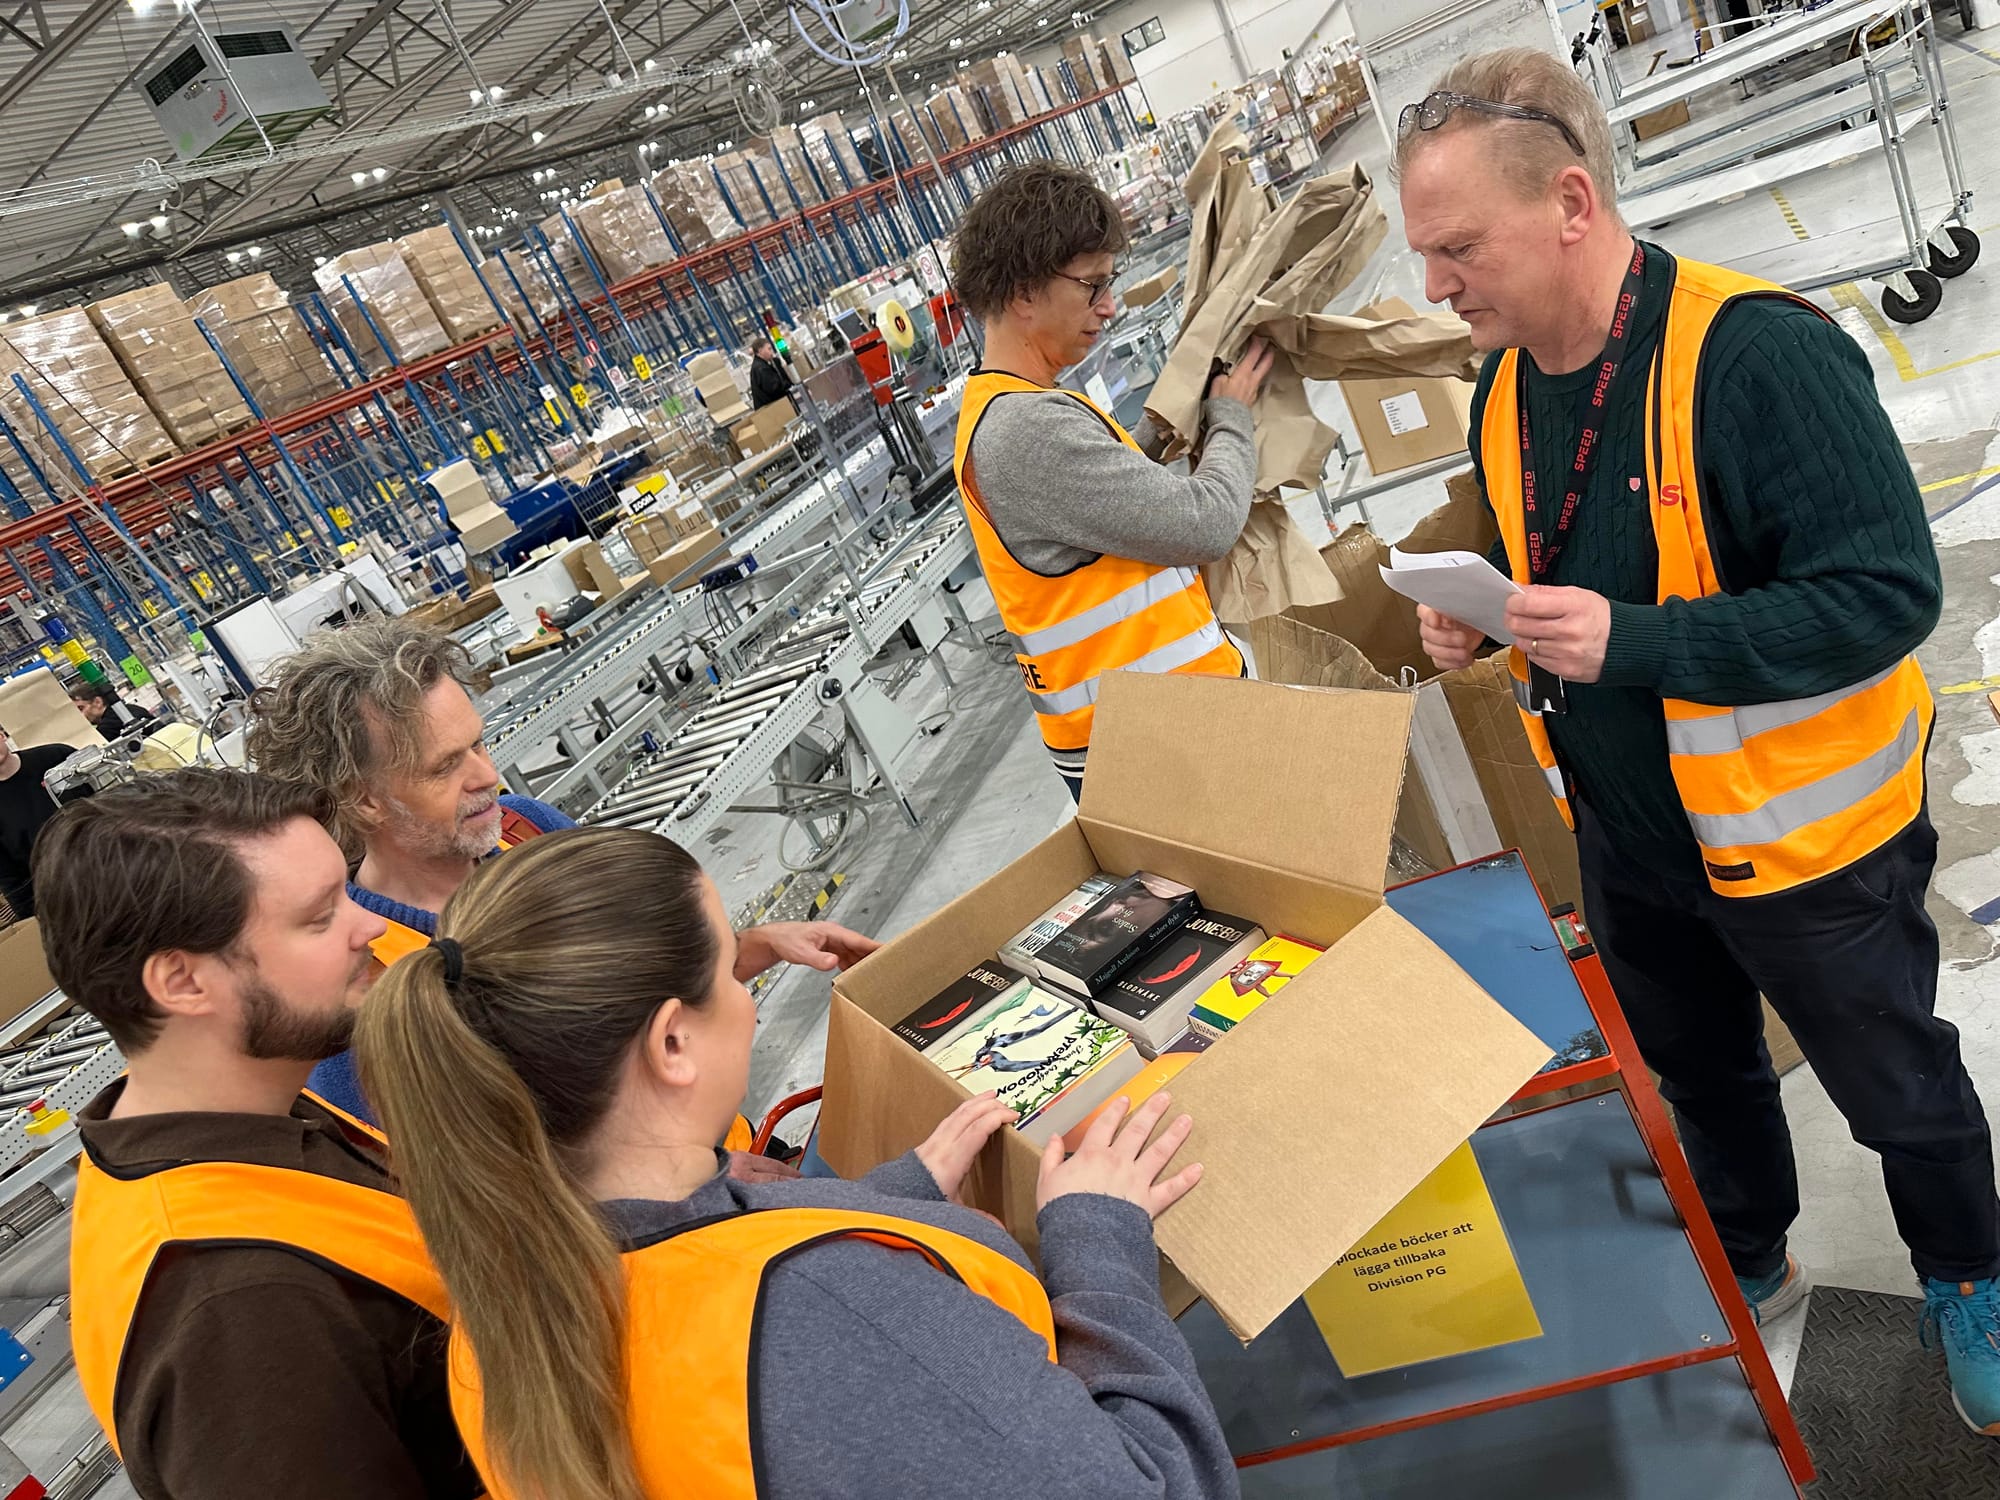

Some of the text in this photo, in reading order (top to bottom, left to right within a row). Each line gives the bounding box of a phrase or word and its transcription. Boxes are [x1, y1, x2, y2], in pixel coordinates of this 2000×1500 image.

[1612, 292, 1632, 339] SPEED
[636, 361, 648, 373] 27
[575, 390, 587, 402] 25
[1592, 361, 1614, 407] SPEED
[1574, 428, 1594, 472] SPEED
[631, 493, 655, 512] ZOOM
[1525, 471, 1536, 512] SPEED
[1558, 492, 1577, 531] SPEED
[1530, 532, 1542, 572] SPEED
[129, 664, 143, 676] 20
[1019, 662, 1047, 689] RE
[1112, 917, 1138, 933] Svalors
[1149, 922, 1170, 941] Svalors
[1018, 933, 1050, 953] ARIN
[996, 1036, 1078, 1098] PTERANODON
[1400, 1229, 1448, 1248] böcker
[1452, 1222, 1474, 1236] att
[1354, 1247, 1447, 1277] lägga tillbaka
[1367, 1265, 1447, 1293] Division PG
